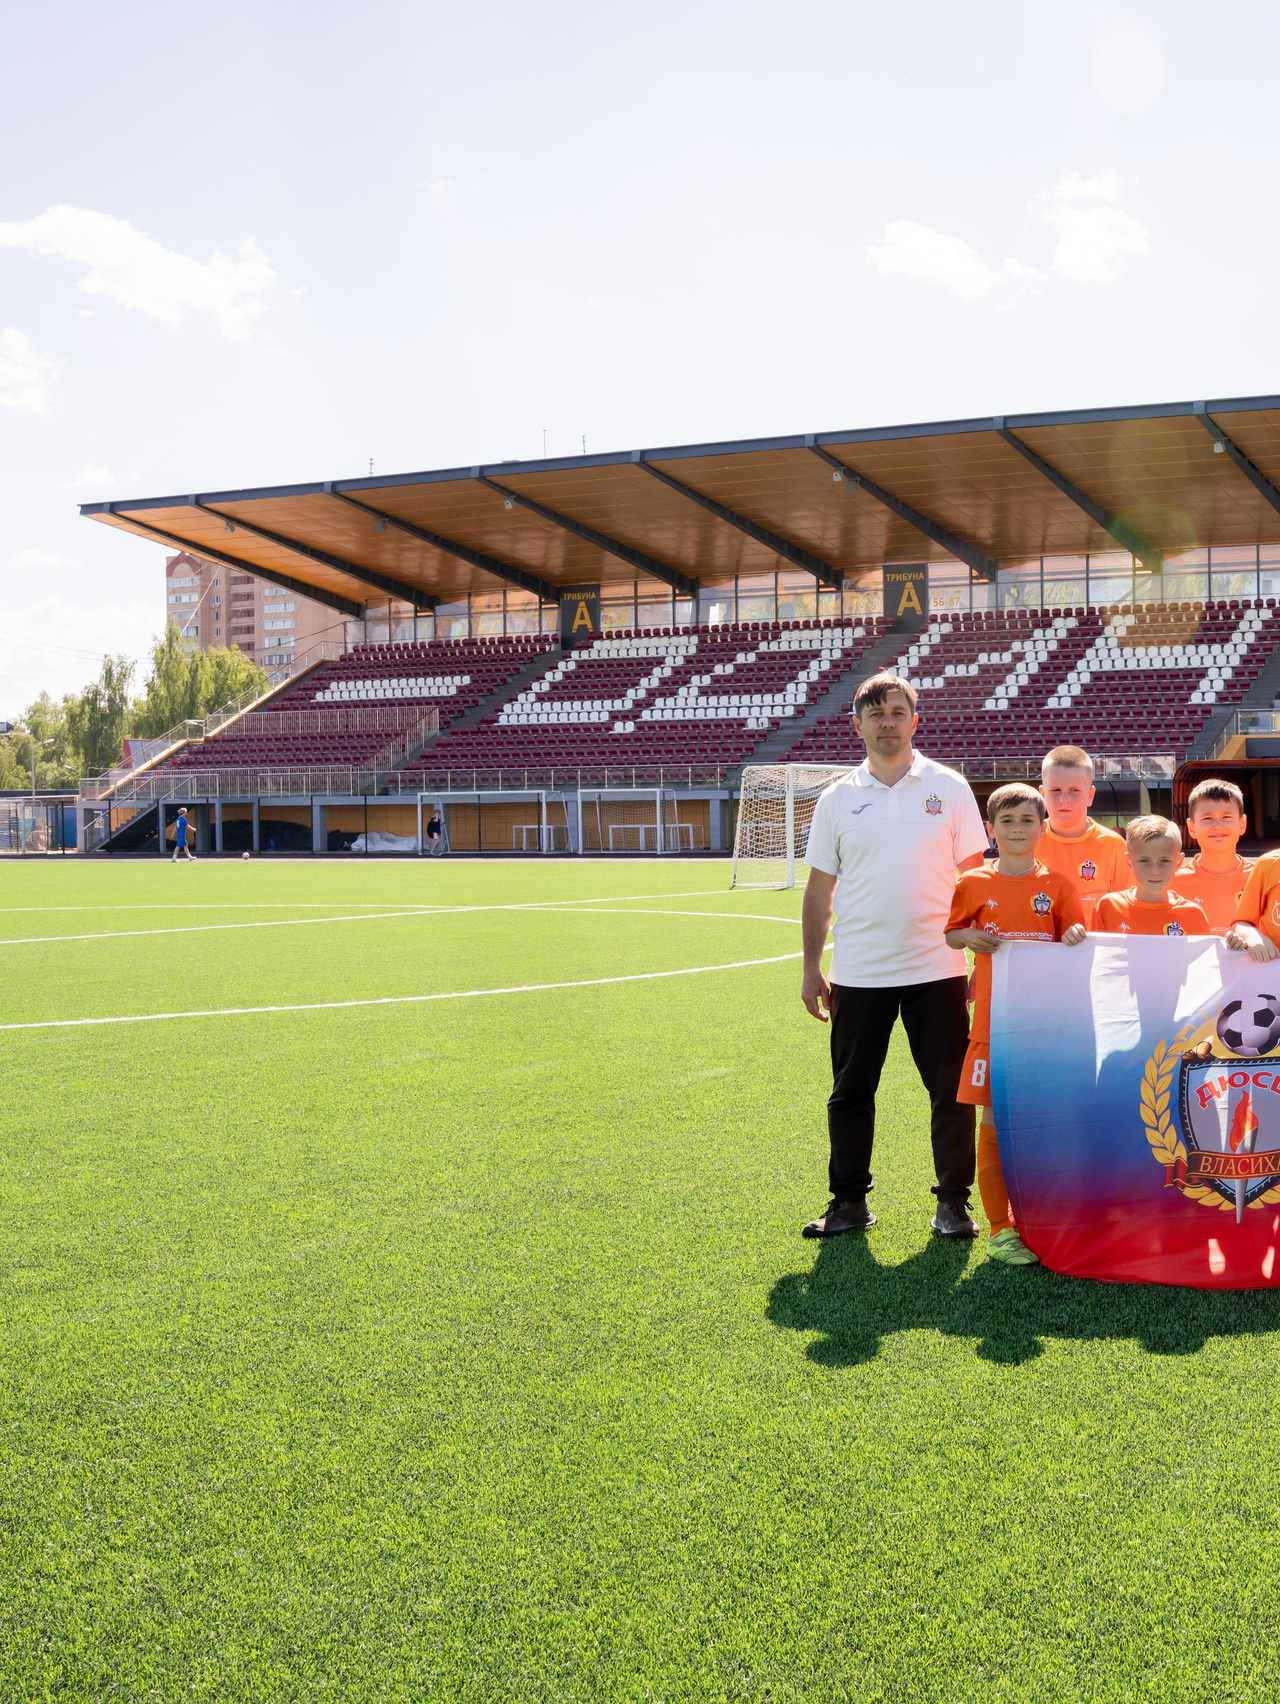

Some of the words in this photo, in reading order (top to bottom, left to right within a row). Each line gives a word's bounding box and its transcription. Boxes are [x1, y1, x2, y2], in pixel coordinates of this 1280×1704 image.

[886, 572, 925, 581] ТРИБУНА
[563, 592, 597, 601] ТРИБУНА
[896, 582, 923, 617] А
[932, 597, 960, 607] 56-87
[571, 601, 594, 634] А
[971, 1059, 987, 1087] 8
